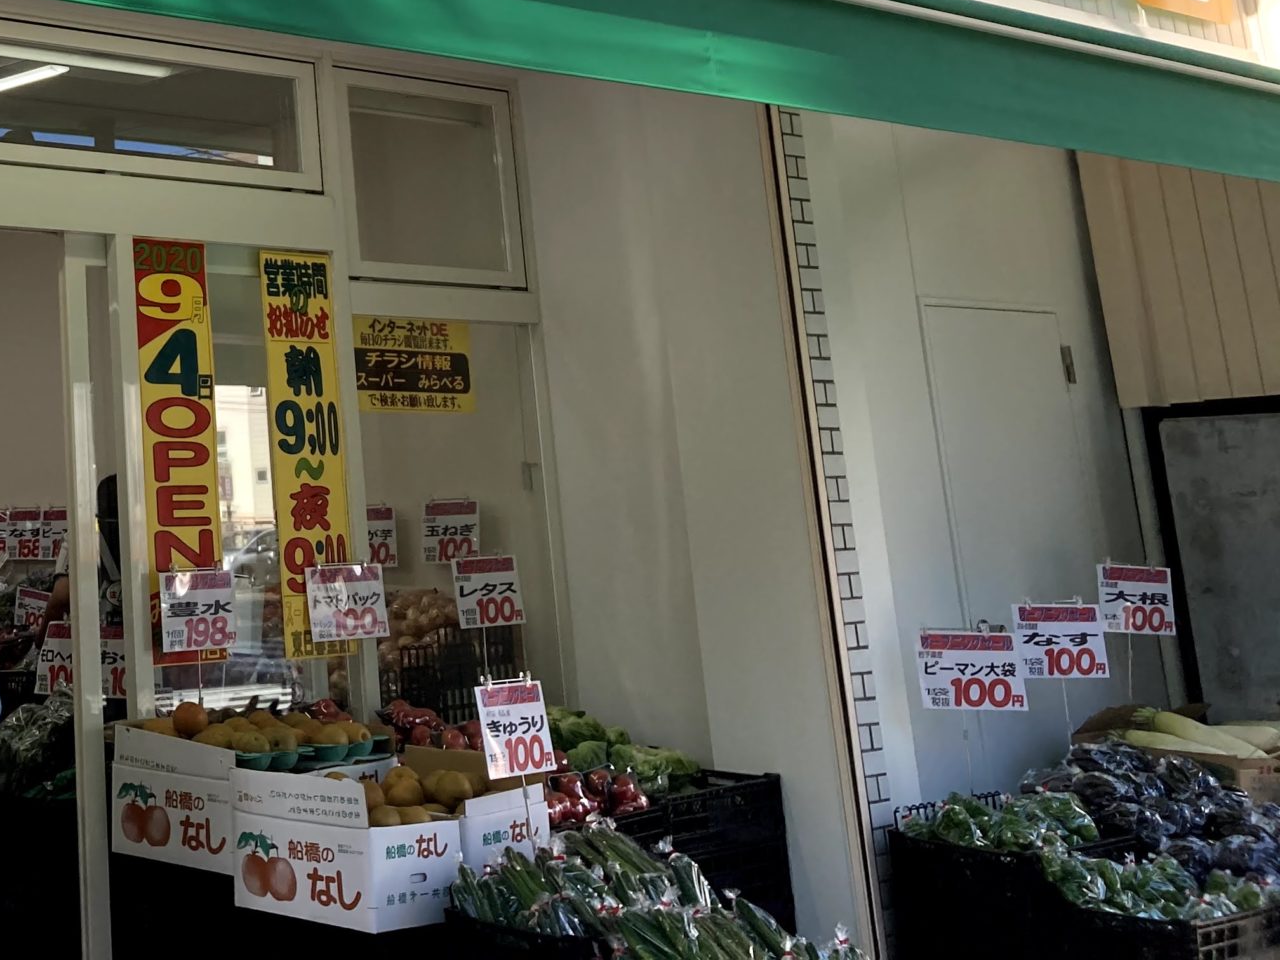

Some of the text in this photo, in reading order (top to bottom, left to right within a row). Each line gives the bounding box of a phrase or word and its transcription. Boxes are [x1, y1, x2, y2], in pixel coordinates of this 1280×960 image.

[134, 243, 202, 275] 2020
[365, 352, 451, 370] チラシ情報
[356, 371, 465, 390] スーパー みらべる
[145, 397, 215, 573] OPEN
[424, 524, 477, 538] 玉ねぎ
[459, 582, 517, 599] レタス
[1104, 591, 1170, 606] 大根
[1022, 632, 1099, 647] なす
[924, 661, 1017, 677] ピーマン大袋
[486, 715, 544, 738] きゅうり
[164, 790, 205, 811] 船橋の
[180, 815, 226, 855] なし
[288, 839, 335, 863] 船橋の
[307, 867, 361, 911] なし
